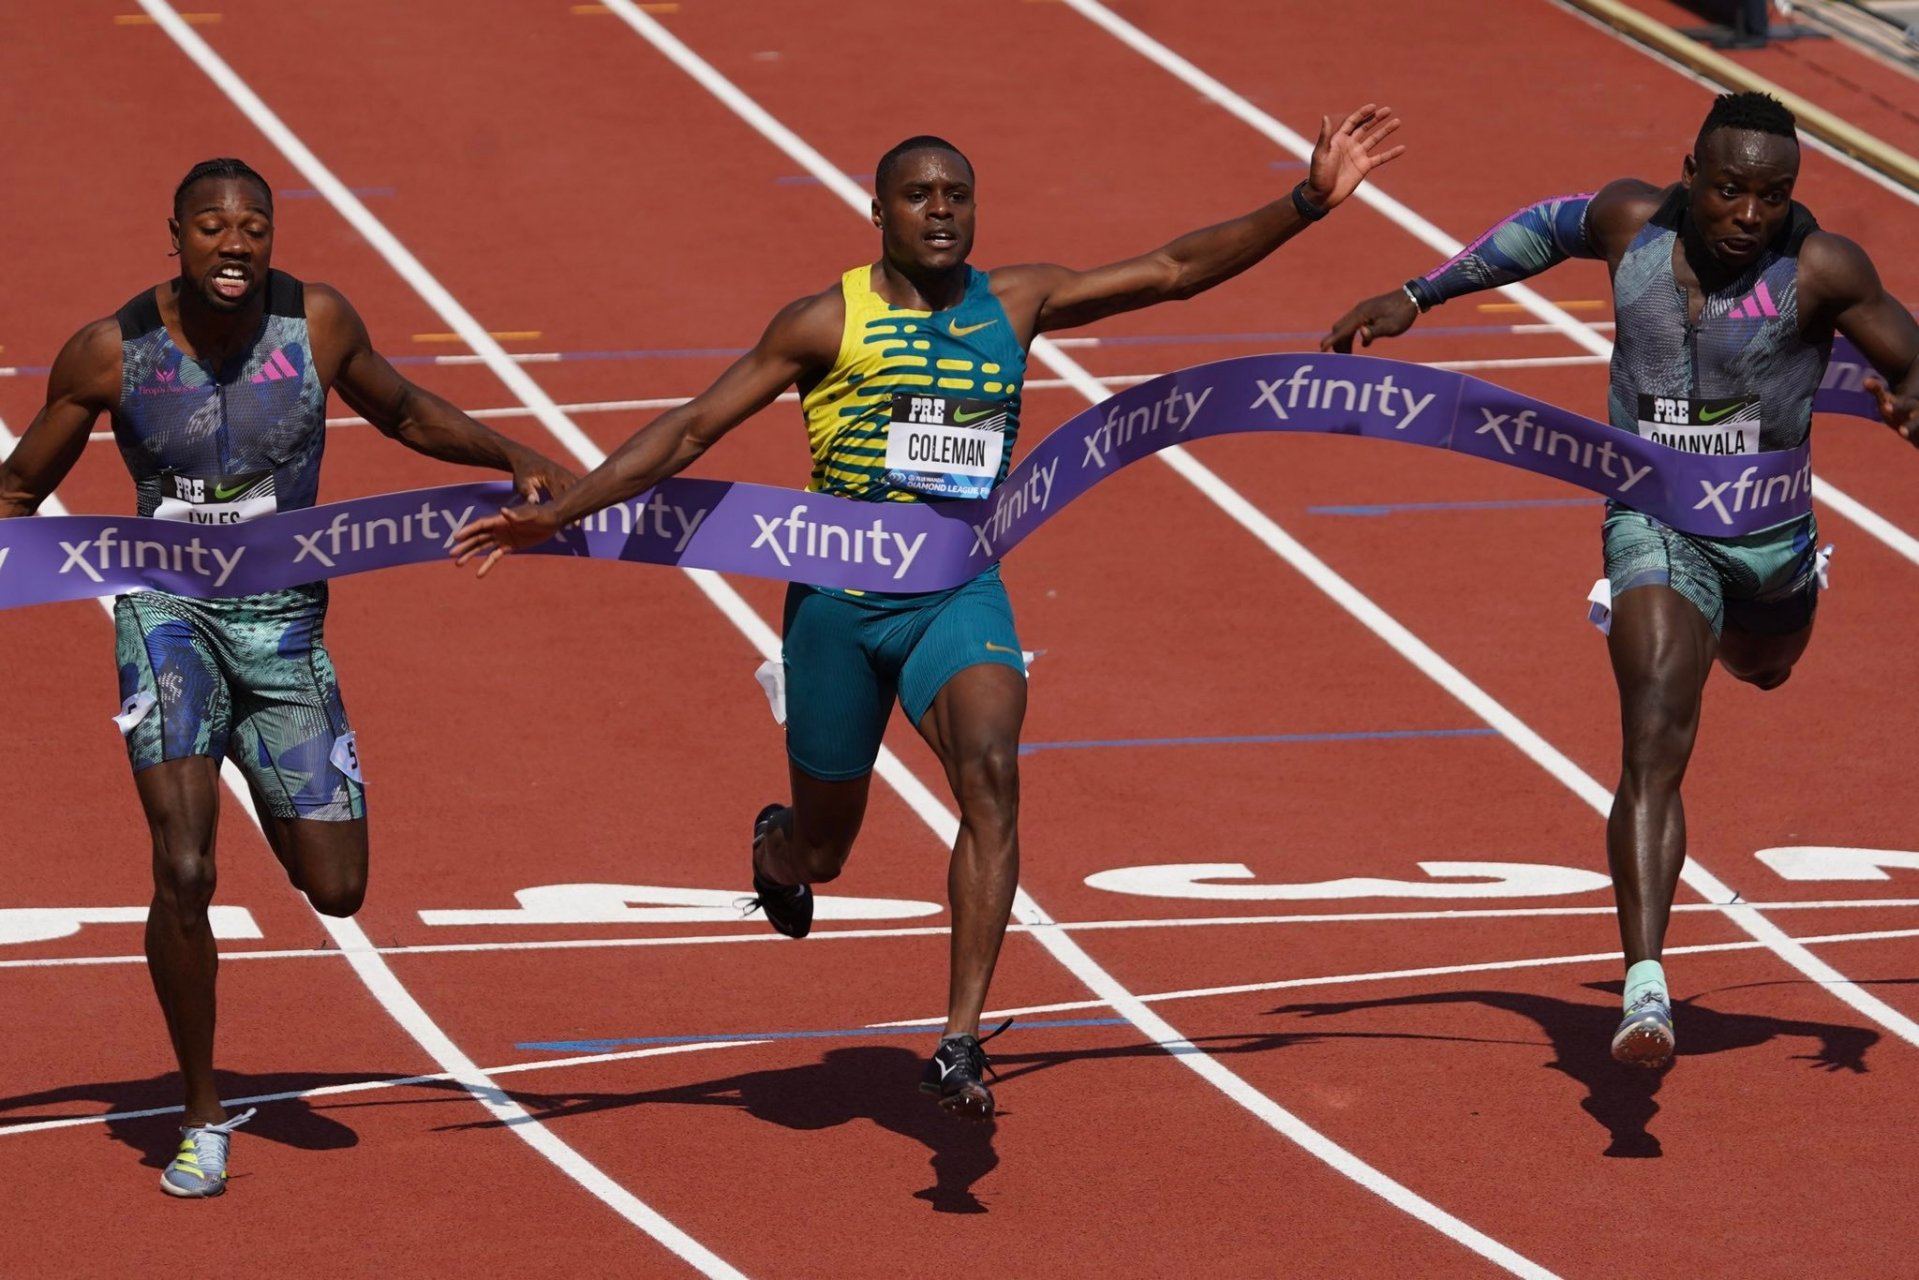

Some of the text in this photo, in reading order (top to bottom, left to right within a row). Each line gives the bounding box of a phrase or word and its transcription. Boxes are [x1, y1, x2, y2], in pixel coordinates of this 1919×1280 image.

[908, 397, 946, 424] PRE
[1081, 385, 1214, 469] xfinity
[1249, 364, 1436, 430] xfinity
[1653, 398, 1689, 424] PRE
[908, 433, 986, 467] COLEMAN
[1474, 407, 1653, 492] xfinity
[174, 475, 205, 503] PRE
[907, 482, 946, 492] DIAMOND
[948, 485, 979, 494] LEAGUE
[968, 456, 1059, 557] xfinity
[1692, 452, 1812, 525] xfinit
[58, 527, 246, 587] xfinity
[293, 502, 475, 567] xfinity
[750, 505, 927, 579] xfinity
